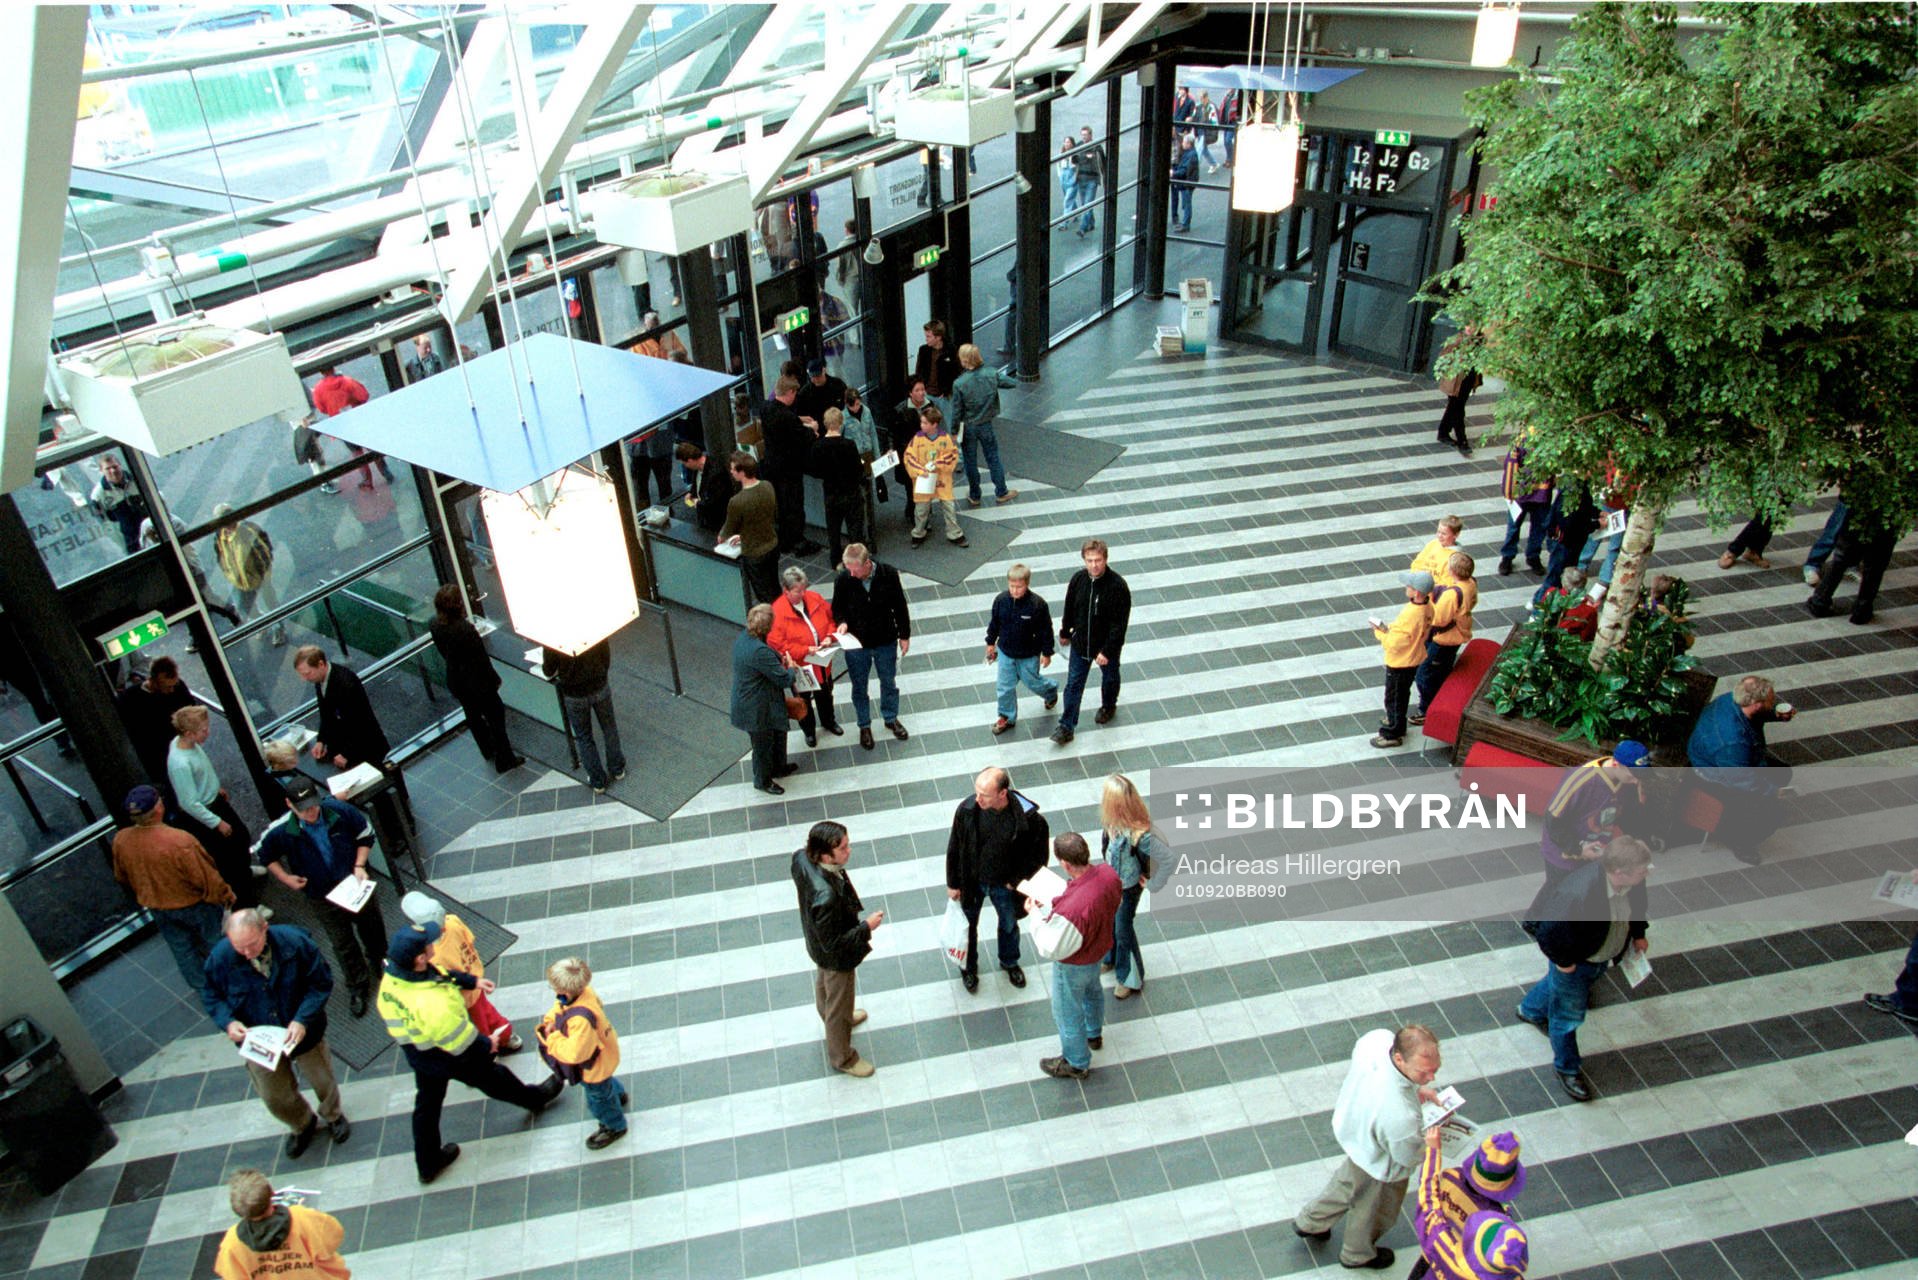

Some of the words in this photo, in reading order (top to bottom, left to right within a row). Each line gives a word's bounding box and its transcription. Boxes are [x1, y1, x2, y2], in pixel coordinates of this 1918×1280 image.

[1353, 145, 1371, 165] I2
[1379, 148, 1399, 168] J2
[1408, 151, 1430, 171] G2
[1349, 171, 1372, 190] H2
[1376, 173, 1396, 193] F2
[250, 1261, 314, 1279] PROGRAM
